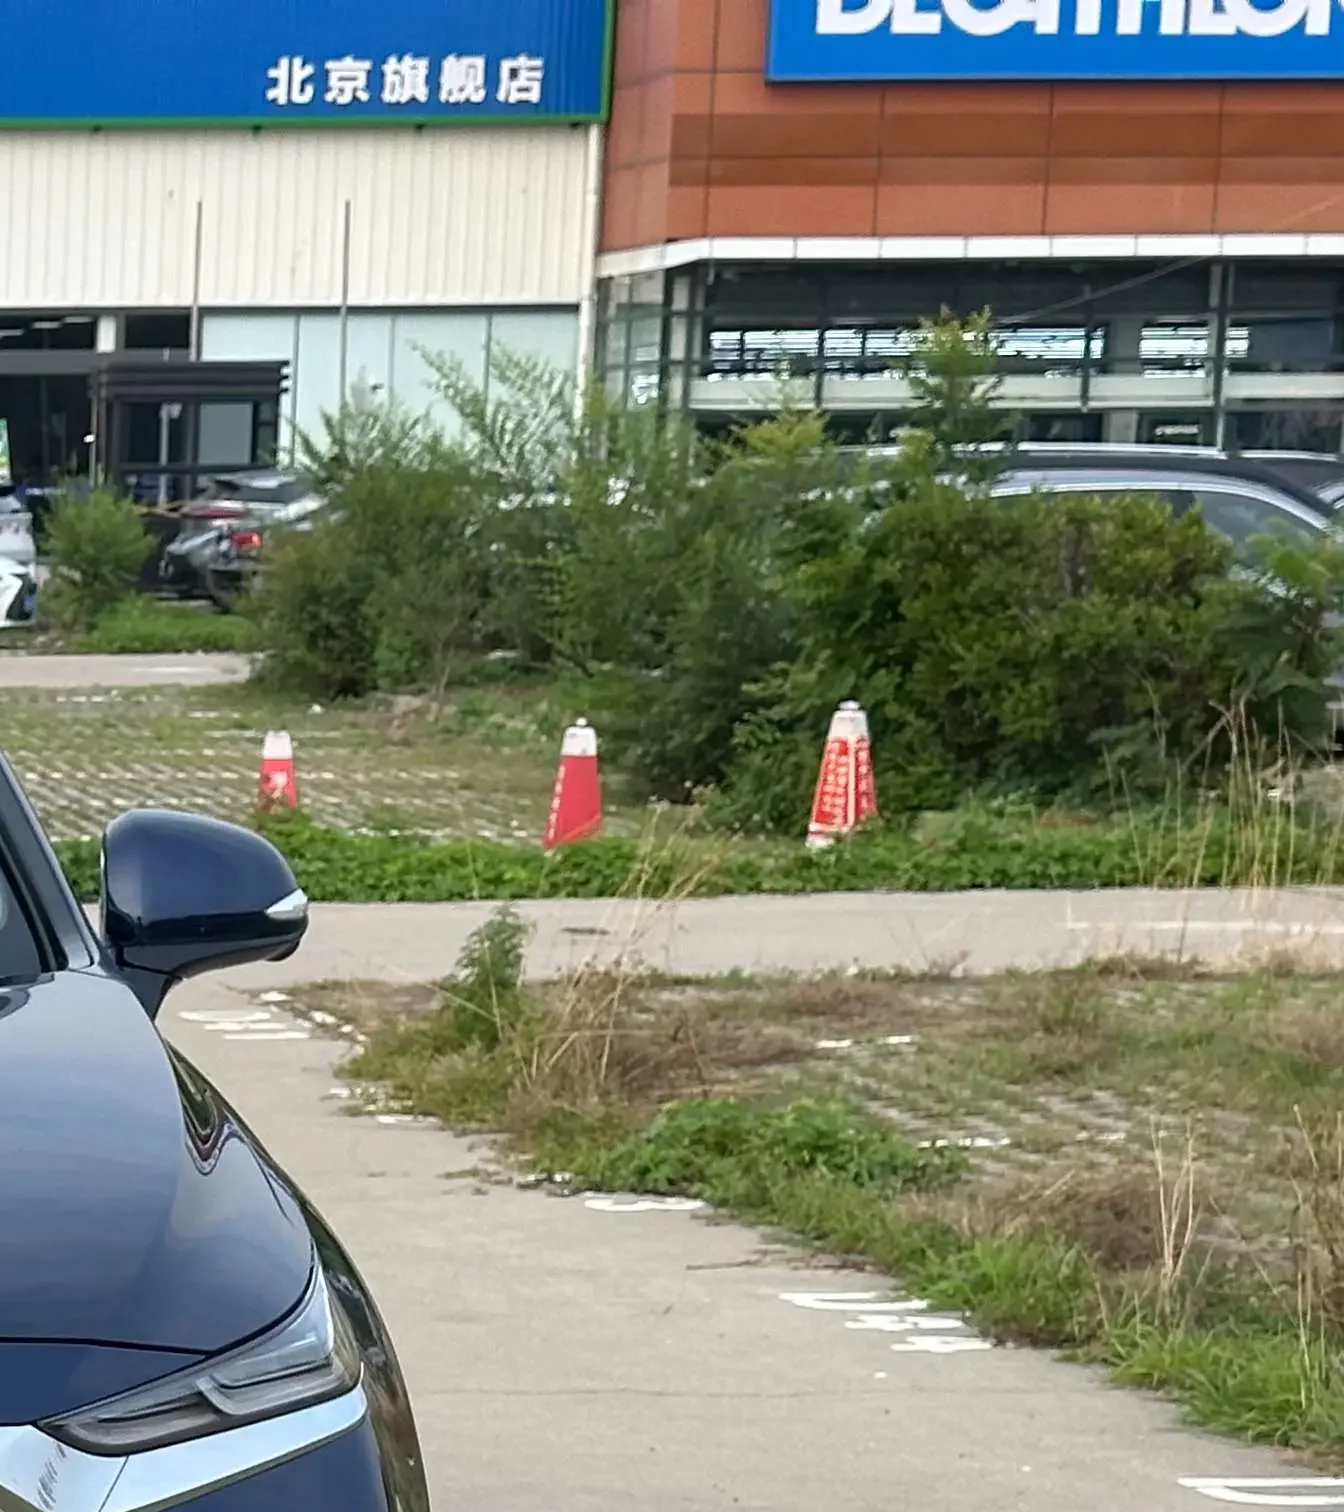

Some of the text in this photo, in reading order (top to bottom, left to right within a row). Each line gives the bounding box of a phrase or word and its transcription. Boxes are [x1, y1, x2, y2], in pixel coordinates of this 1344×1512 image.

[266, 53, 545, 104] 北京旗舰店
